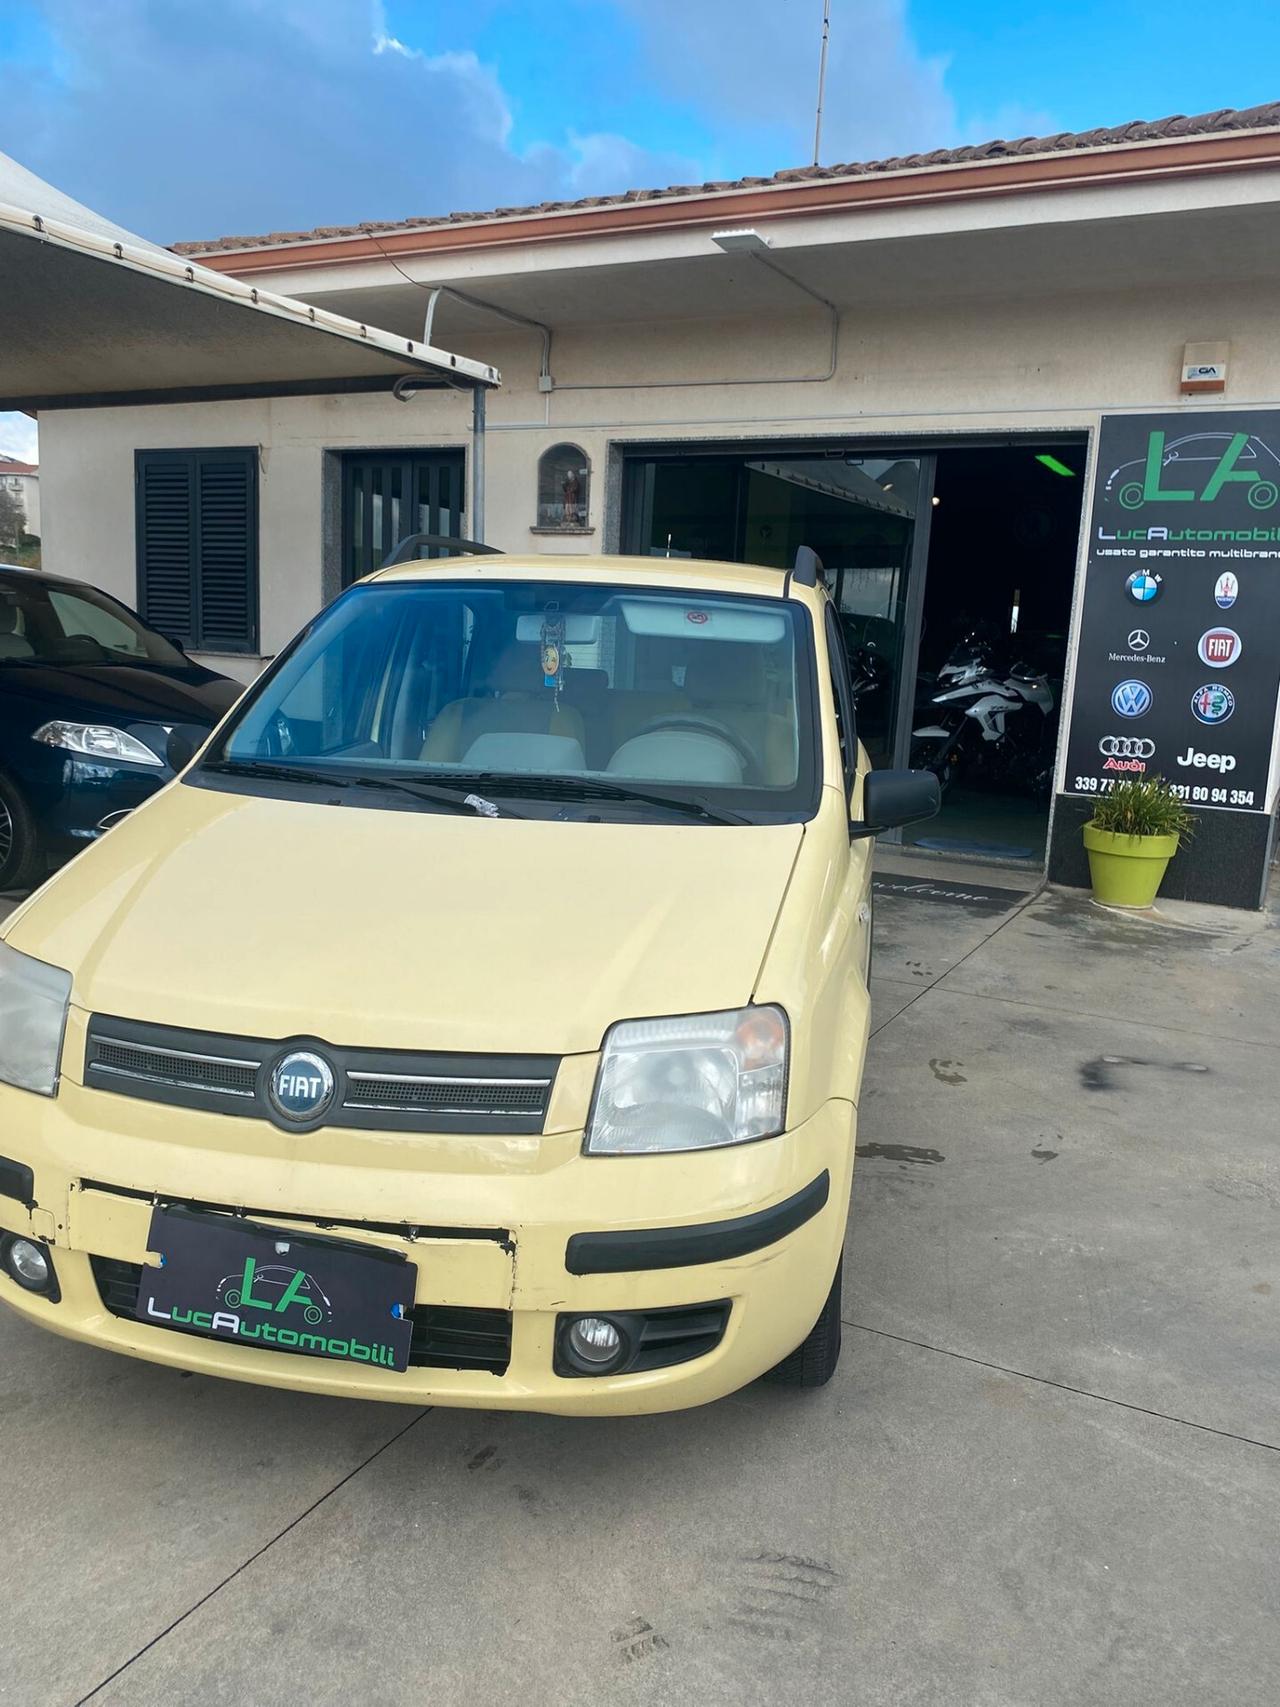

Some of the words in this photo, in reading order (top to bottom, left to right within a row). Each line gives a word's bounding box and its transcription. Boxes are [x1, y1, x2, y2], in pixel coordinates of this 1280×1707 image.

[1096, 548, 1136, 556] usato
[1139, 547, 1206, 558] garantito
[1209, 548, 1280, 558] multibran
[1208, 638, 1233, 657] FIAT
[1108, 652, 1166, 664] Mercedes-Benz
[1102, 757, 1146, 772] Audi
[1177, 747, 1236, 773] Jeep
[1075, 776, 1098, 790] 339
[1193, 786, 1208, 801] 80
[1211, 788, 1226, 803] 94
[1229, 790, 1254, 805] 354
[278, 1074, 322, 1099] FIAT
[147, 1297, 395, 1366] LucAutomobili
